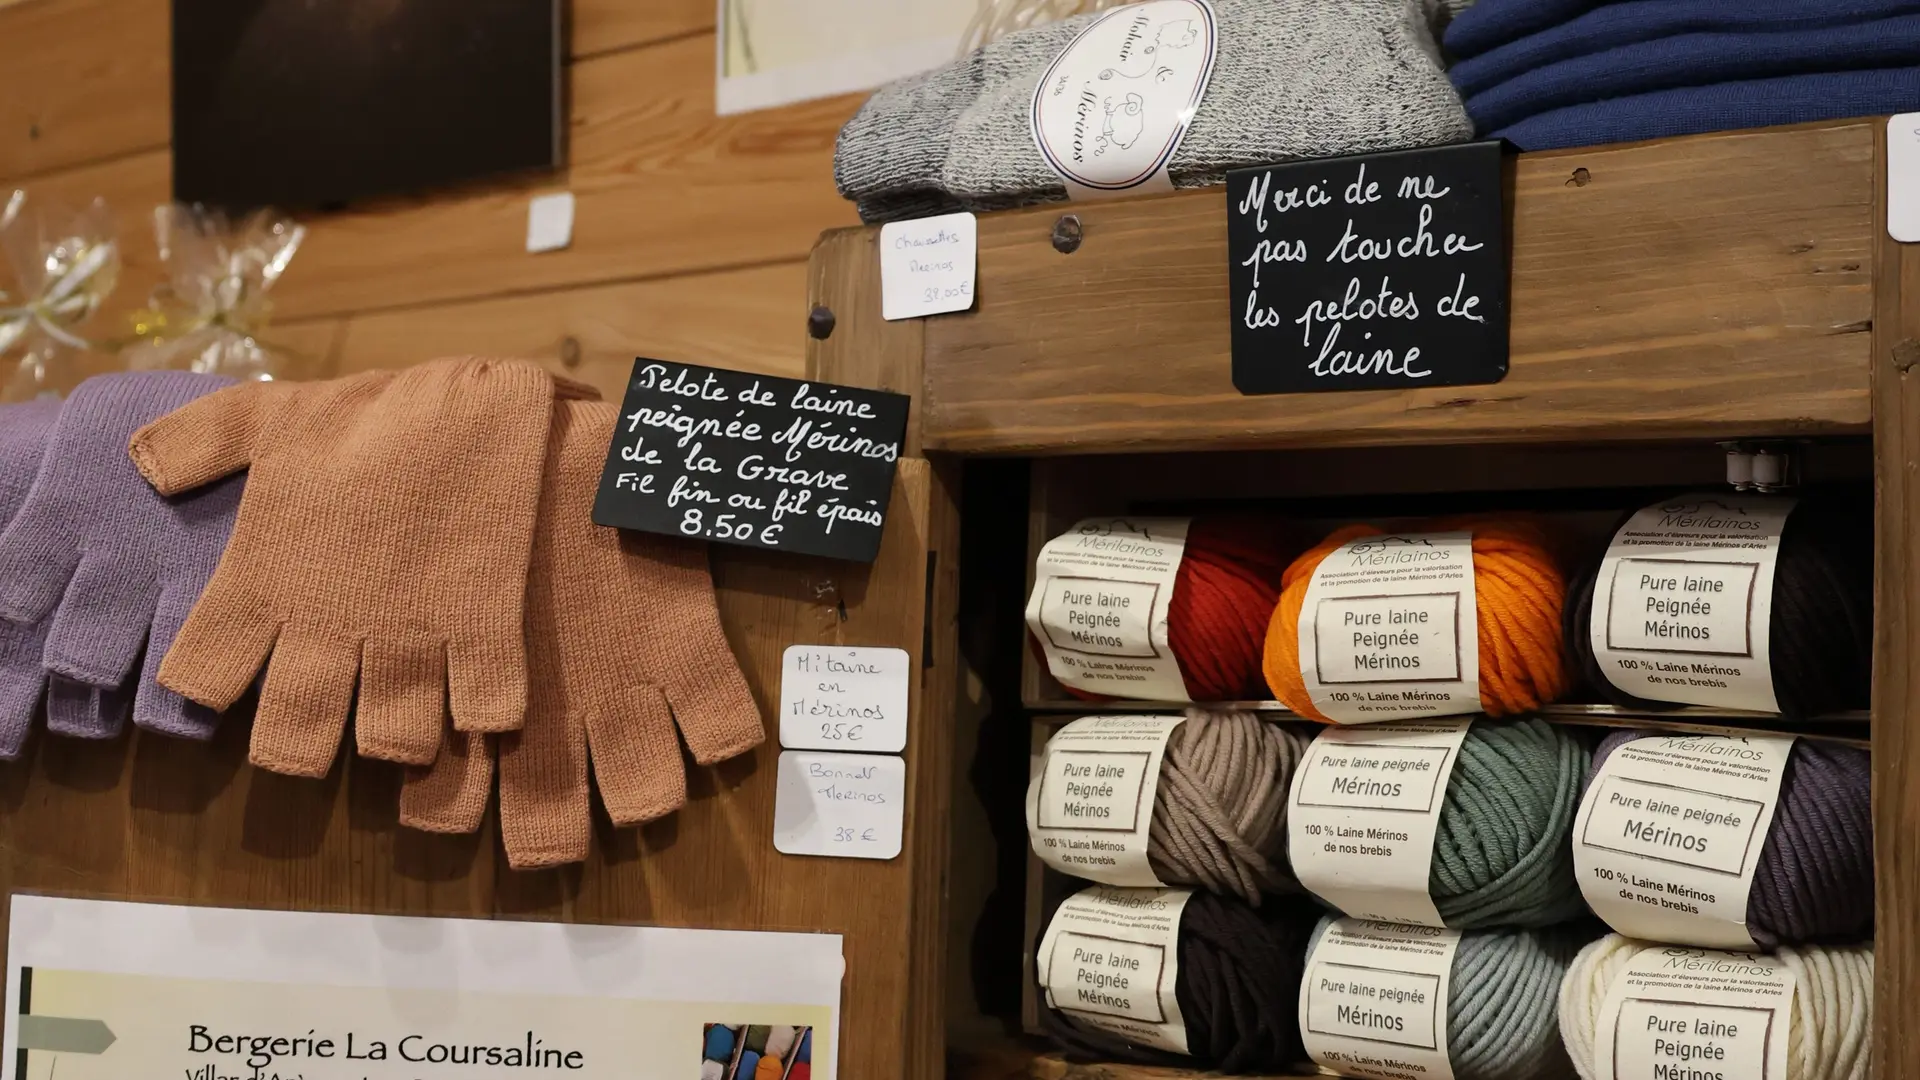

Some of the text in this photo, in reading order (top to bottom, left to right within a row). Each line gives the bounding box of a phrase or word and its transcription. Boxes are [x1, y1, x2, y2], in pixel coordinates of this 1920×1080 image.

[1119, 8, 1150, 62] Mohair
[1072, 80, 1097, 164] Mérinos
[1239, 163, 1451, 233] Merci de ne
[1242, 239, 1308, 288] pas
[1244, 273, 1486, 347] les pelotes de
[1308, 322, 1432, 378] laine
[640, 363, 876, 419] Pelote de laine
[627, 404, 898, 463] peignée Mérinos
[621, 437, 849, 491] de la Grave
[615, 472, 883, 534] Fil fin ou fil épais
[1076, 536, 1164, 557] Mérilainos
[1351, 550, 1450, 567] Mérilainos
[1639, 574, 1724, 593] Pure laine
[1062, 590, 1130, 608] Pure laine
[1646, 596, 1711, 617] Peignée
[1069, 611, 1120, 628] Peignée
[1344, 609, 1429, 626] Pure laine
[1071, 631, 1123, 647] Mérinos
[1353, 629, 1419, 649] Peignée
[1644, 620, 1710, 640] Mérinos
[798, 652, 882, 674] Mitaine
[1354, 652, 1420, 670] Mérinos
[1617, 659, 1741, 676] 100 % Laine Mérinos
[818, 682, 846, 693] en
[1647, 675, 1727, 689] de nos brebis
[1329, 689, 1450, 702] 100 % Laine Mérinos
[793, 698, 885, 720] Mérinos
[1358, 704, 1437, 712] de nos brebis
[1660, 739, 1763, 761] Mérilainos
[1063, 763, 1125, 778] Pure laine
[1320, 755, 1431, 772] Pure laine peignée
[1065, 782, 1113, 799] Peignée
[1331, 776, 1402, 797] Mérinos
[1063, 802, 1110, 818] Mérinos
[1610, 792, 1741, 827] Pure laine peignée
[1305, 825, 1408, 841] 100 % Laine Mérinos
[1623, 819, 1708, 853] Mérinos
[1043, 838, 1057, 848] 100
[1068, 839, 1090, 849] Laine
[1092, 839, 1125, 851] Mérinos
[1324, 842, 1392, 857] de nos brebis
[1062, 855, 1116, 865] de nos brebis
[1593, 867, 1716, 904] 100 % Laine Mérinos
[1619, 888, 1699, 915] de nos brebis
[1073, 947, 1140, 971] Pure laine
[1663, 957, 1773, 976] Mérilainos
[1077, 968, 1129, 989] Peignée
[1078, 989, 1131, 1009] Mérinos
[1320, 978, 1425, 1004] Pure laine peignée
[1337, 1005, 1404, 1031] Mérinos
[1647, 1015, 1738, 1037] Pure laine
[188, 1024, 584, 1069] Bergerie La Coursaline
[1655, 1038, 1725, 1061] Peignée
